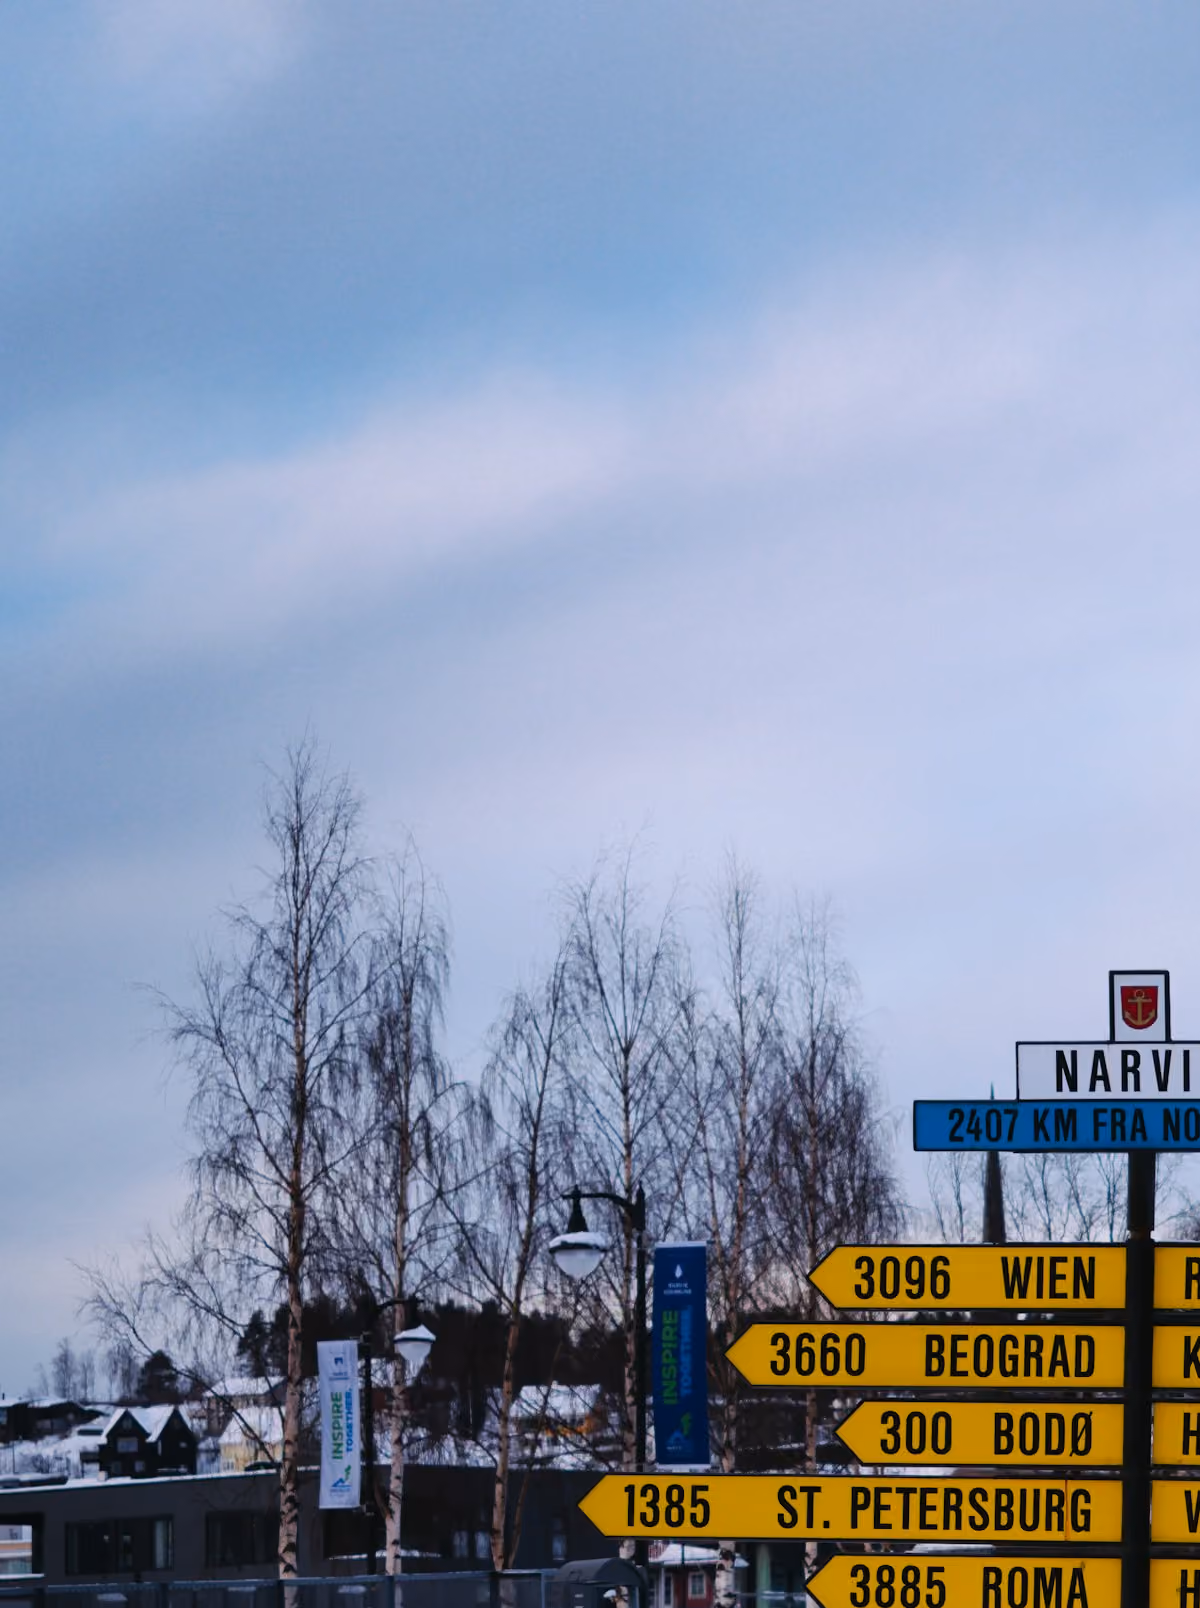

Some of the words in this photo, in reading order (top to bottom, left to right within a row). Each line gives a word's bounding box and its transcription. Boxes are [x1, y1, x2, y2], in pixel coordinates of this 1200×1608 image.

[949, 1109, 1018, 1142] 2407
[1034, 1109, 1076, 1142] KM
[1094, 1109, 1147, 1141] FRA
[855, 1256, 950, 1299] 3096
[1001, 1256, 1096, 1299] WIEN
[662, 1310, 679, 1405] INSPIRE
[771, 1333, 865, 1376] 3660
[925, 1334, 1094, 1377] BEOGRAD
[330, 1391, 344, 1460] INSPIRE
[881, 1411, 951, 1454] 300
[994, 1412, 1092, 1456] BODØ
[625, 1484, 710, 1528] 1385
[778, 1485, 829, 1528] ST.
[851, 1487, 1090, 1532] PETERSBURG
[850, 1565, 945, 1608] 3885
